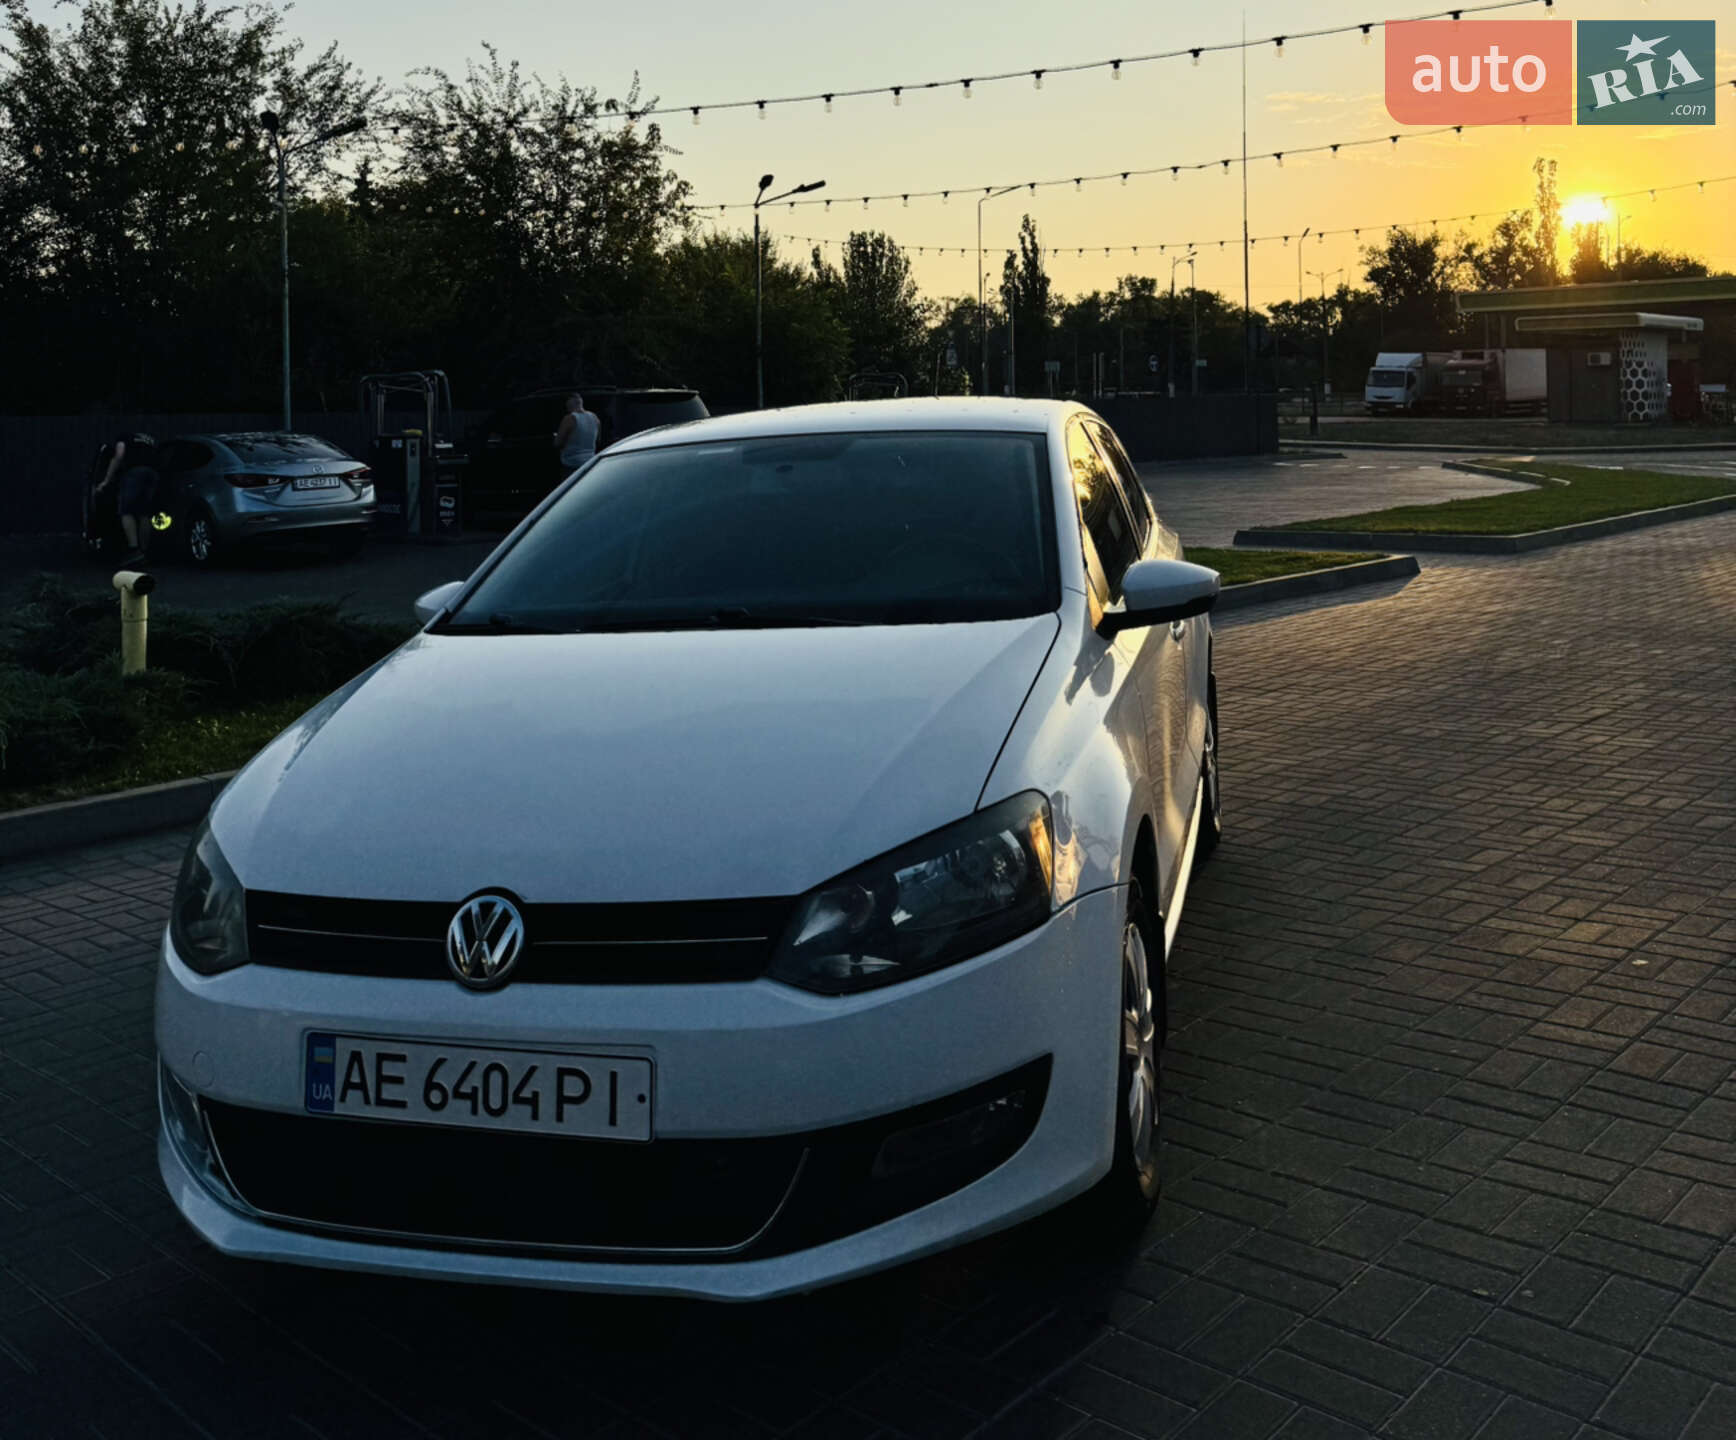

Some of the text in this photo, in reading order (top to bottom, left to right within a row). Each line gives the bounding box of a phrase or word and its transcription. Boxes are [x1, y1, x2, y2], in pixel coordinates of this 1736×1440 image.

[312, 1083, 333, 1101] UA
[340, 1051, 407, 1109] AE
[423, 1058, 539, 1121] 6404
